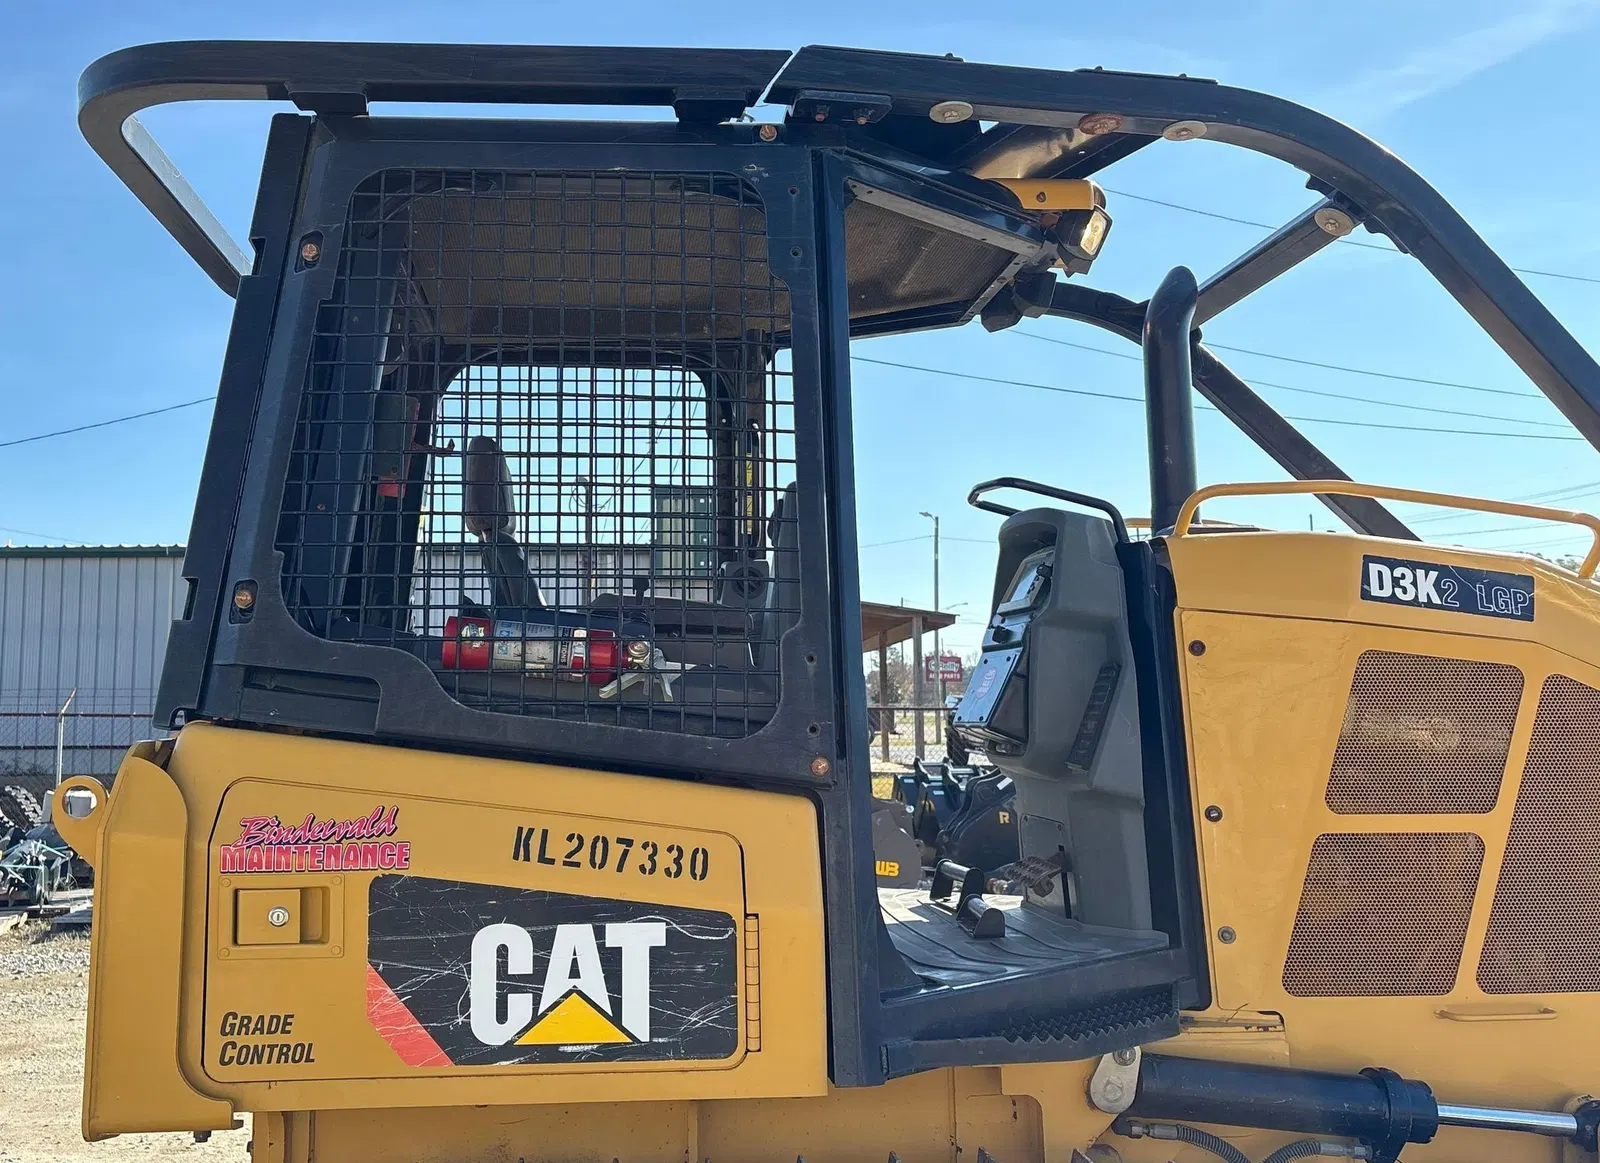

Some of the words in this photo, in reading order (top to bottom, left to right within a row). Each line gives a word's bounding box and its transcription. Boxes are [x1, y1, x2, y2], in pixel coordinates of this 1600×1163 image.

[1476, 584, 1530, 615] LGP
[234, 806, 399, 848] Bindewald
[220, 843, 411, 872] MAINTENANCE
[512, 826, 709, 881] KL207330
[470, 922, 667, 1046] CAT
[220, 1011, 295, 1036] GRADE
[219, 1041, 315, 1066] CONTROL
